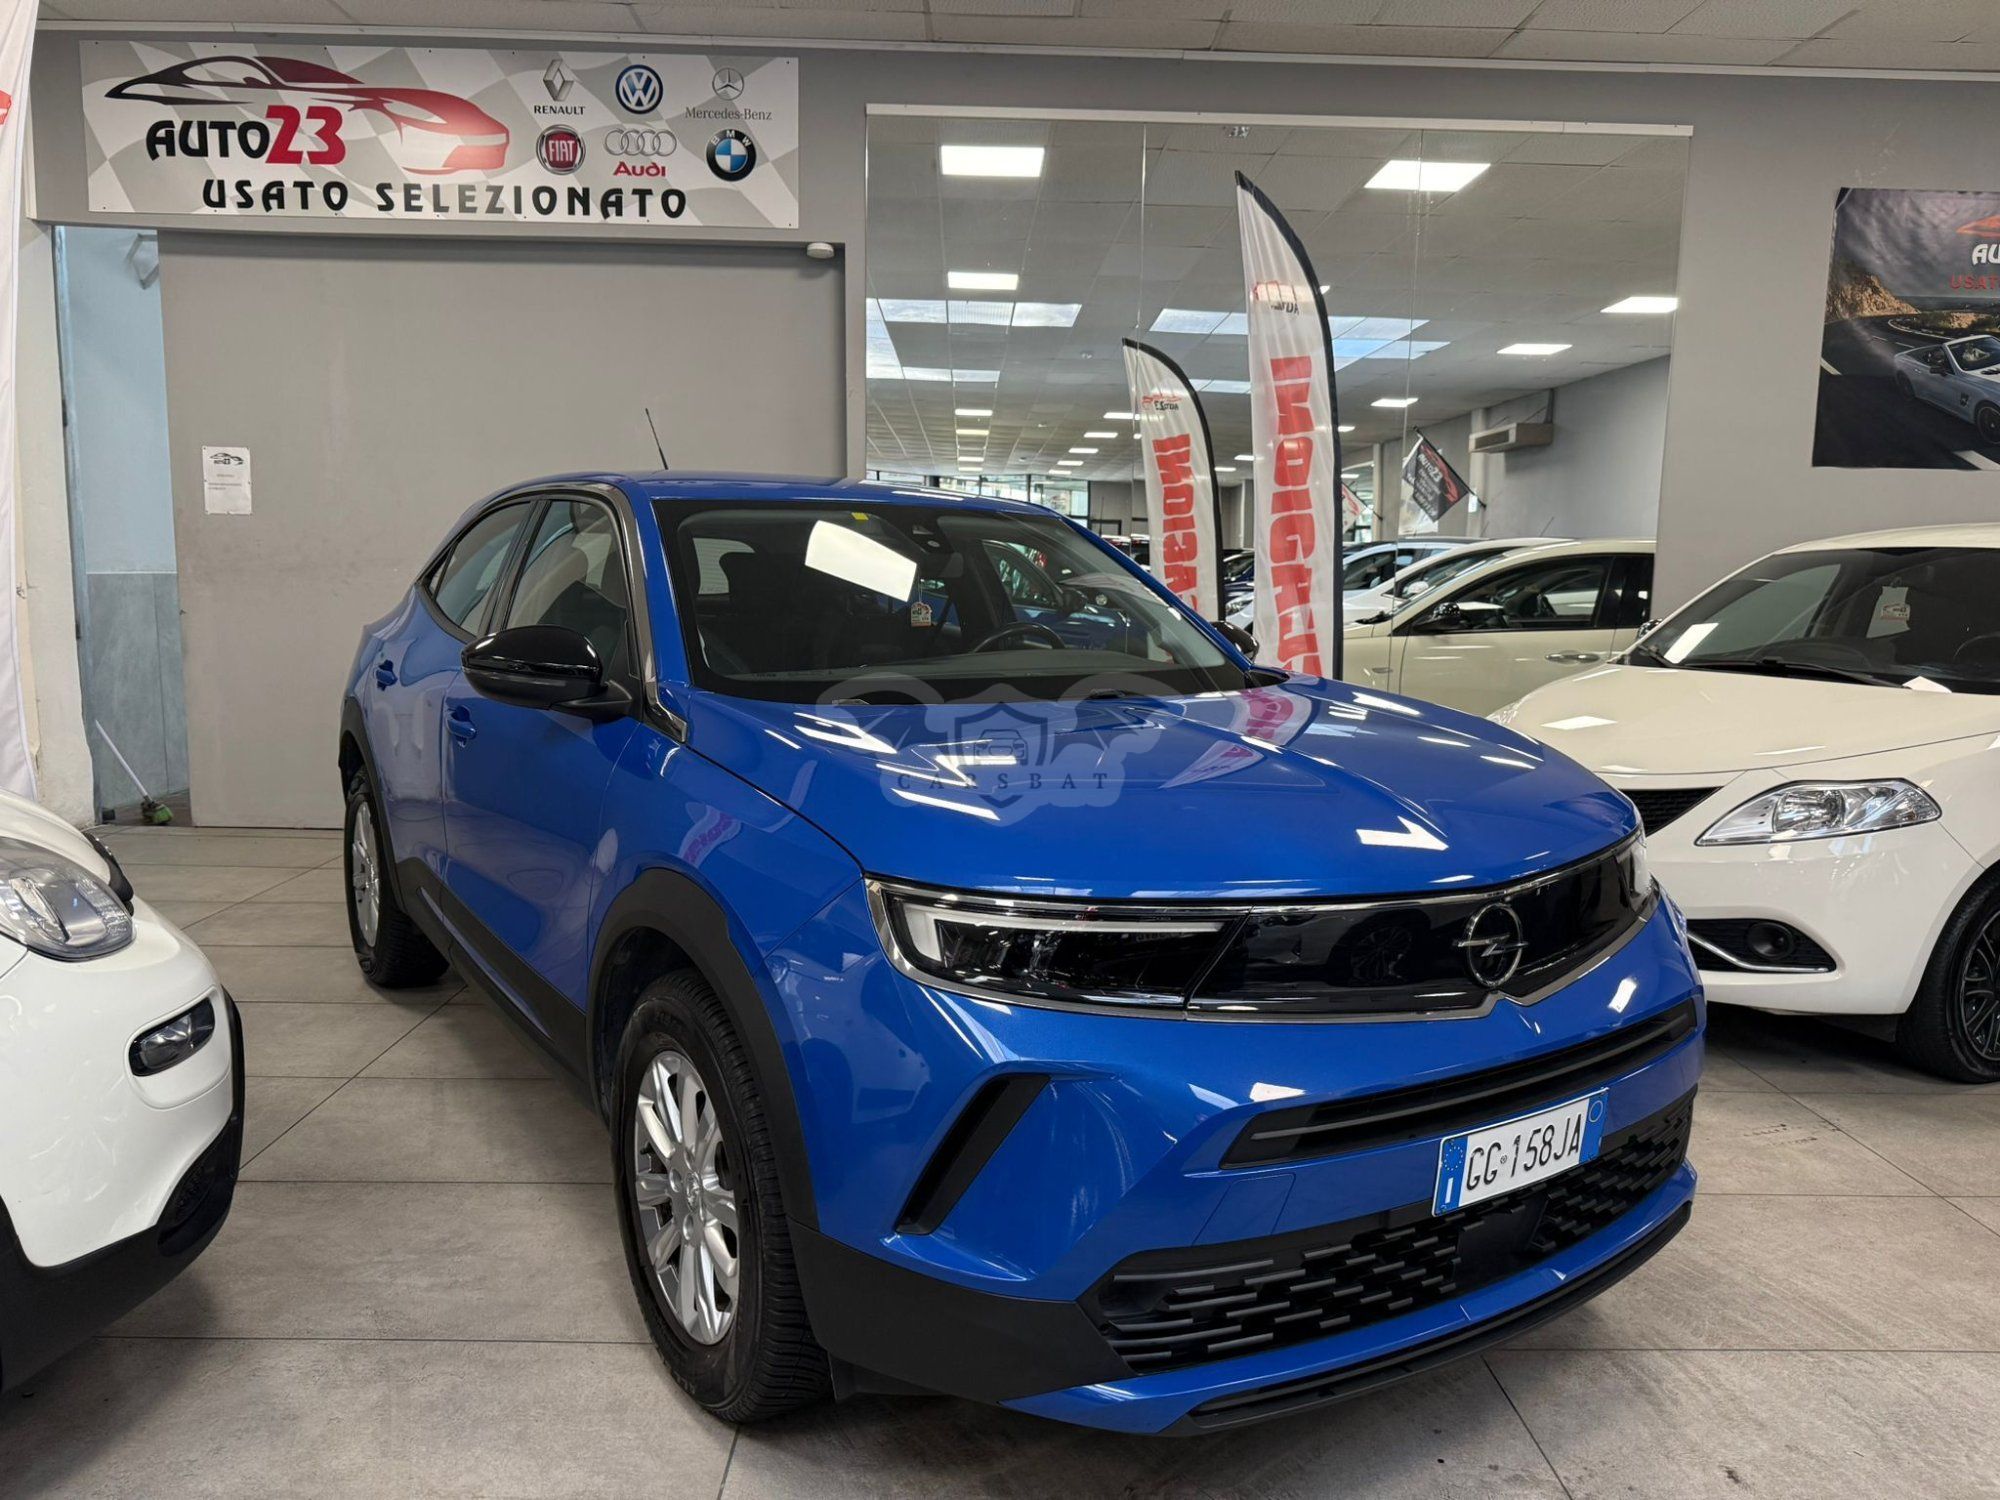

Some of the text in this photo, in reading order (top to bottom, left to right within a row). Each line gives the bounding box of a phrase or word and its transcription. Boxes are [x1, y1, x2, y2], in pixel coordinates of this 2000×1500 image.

[534, 105, 585, 116] RENAULT
[685, 107, 772, 121] Mercedes-Benz
[548, 140, 576, 163] FIAT
[613, 161, 666, 177] Audi
[202, 179, 687, 220] USATO SELEZIONATO
[1951, 275, 2000, 290] USAT
